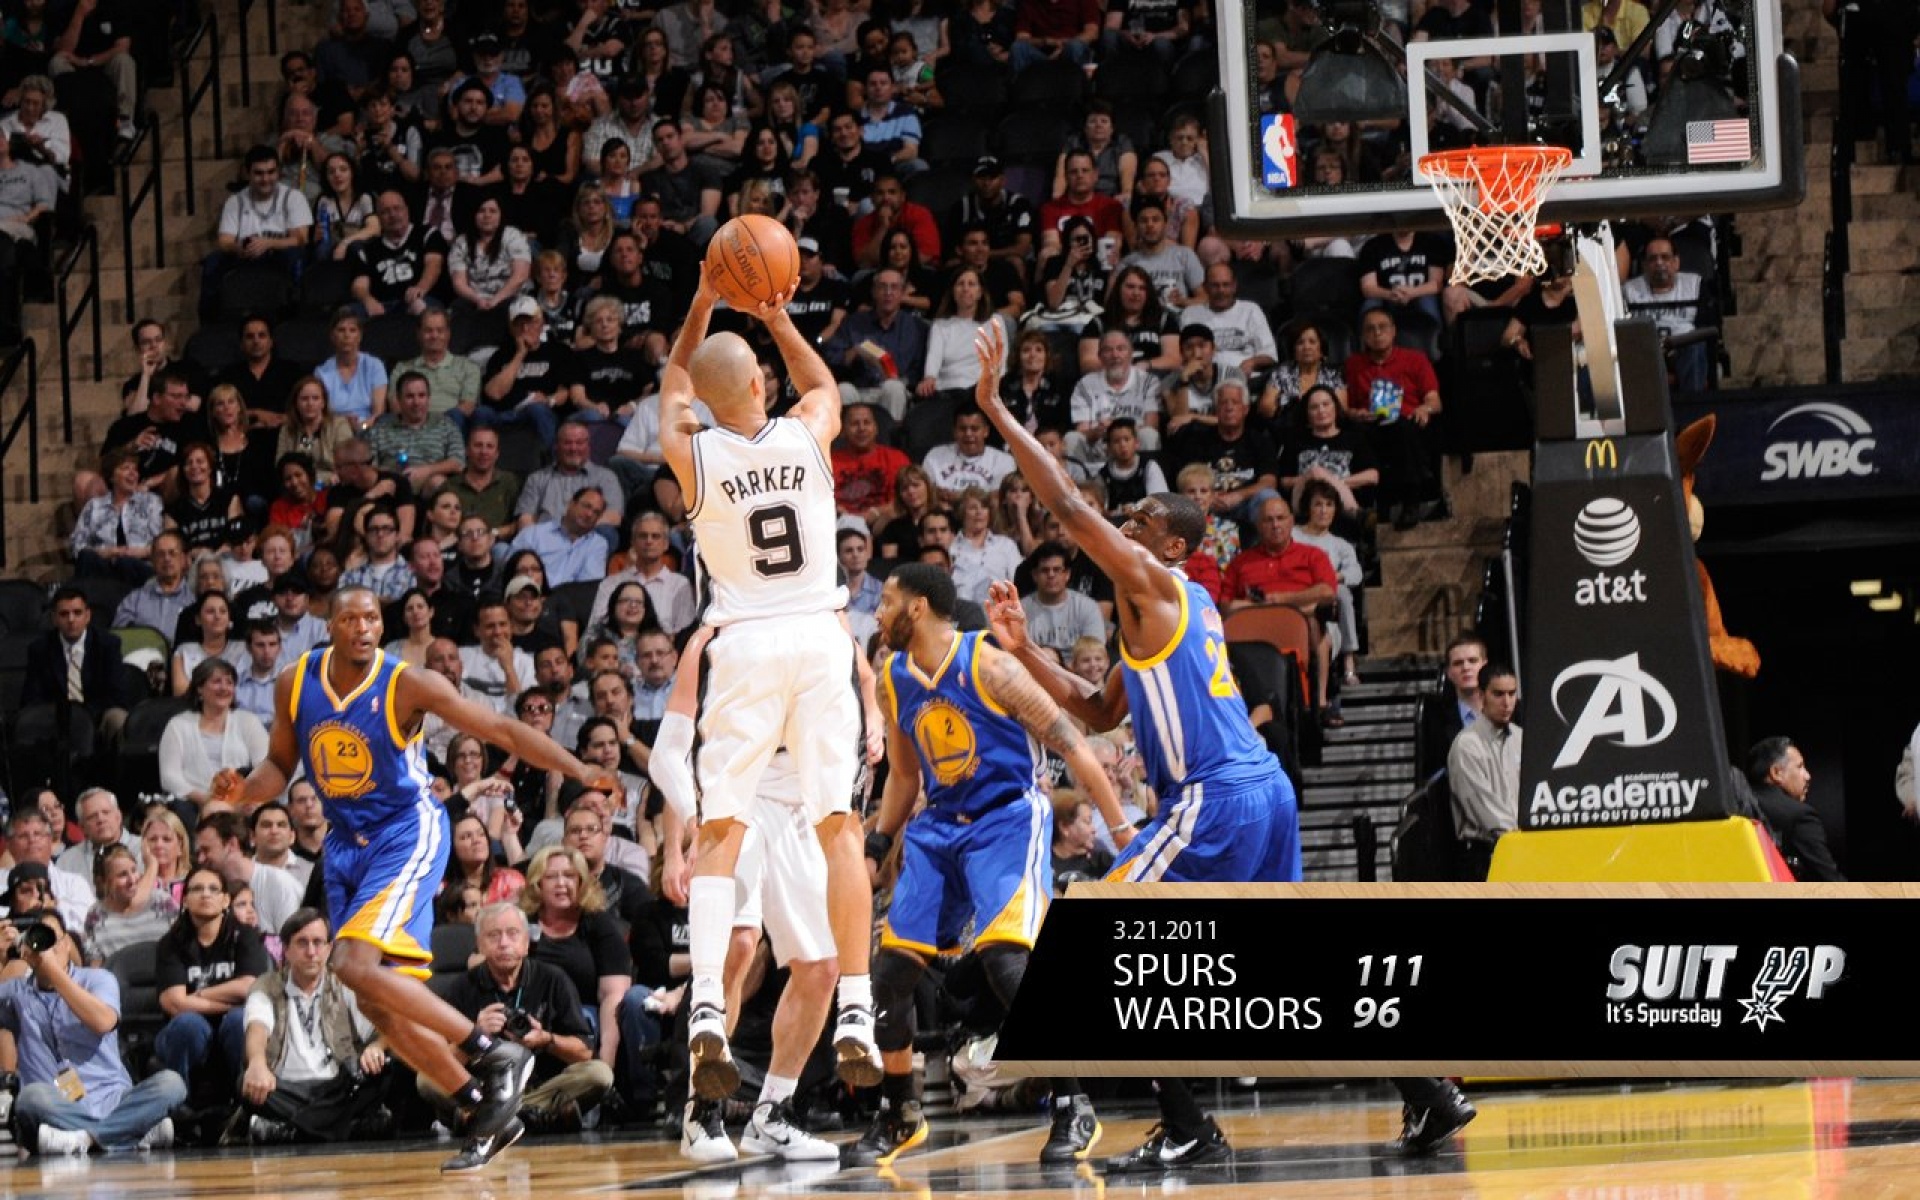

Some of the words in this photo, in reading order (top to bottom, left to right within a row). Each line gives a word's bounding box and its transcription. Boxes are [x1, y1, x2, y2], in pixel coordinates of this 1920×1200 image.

[1760, 437, 1876, 482] SWBC
[720, 465, 805, 504] PARKER
[744, 501, 808, 580] 9
[1574, 569, 1648, 606] at&t
[945, 718, 954, 736] 2
[337, 741, 357, 757] 23
[1531, 775, 1701, 814] Academy
[1624, 772, 1679, 783] academy.com
[1531, 806, 1684, 826] SPORTS+OUTDOORS
